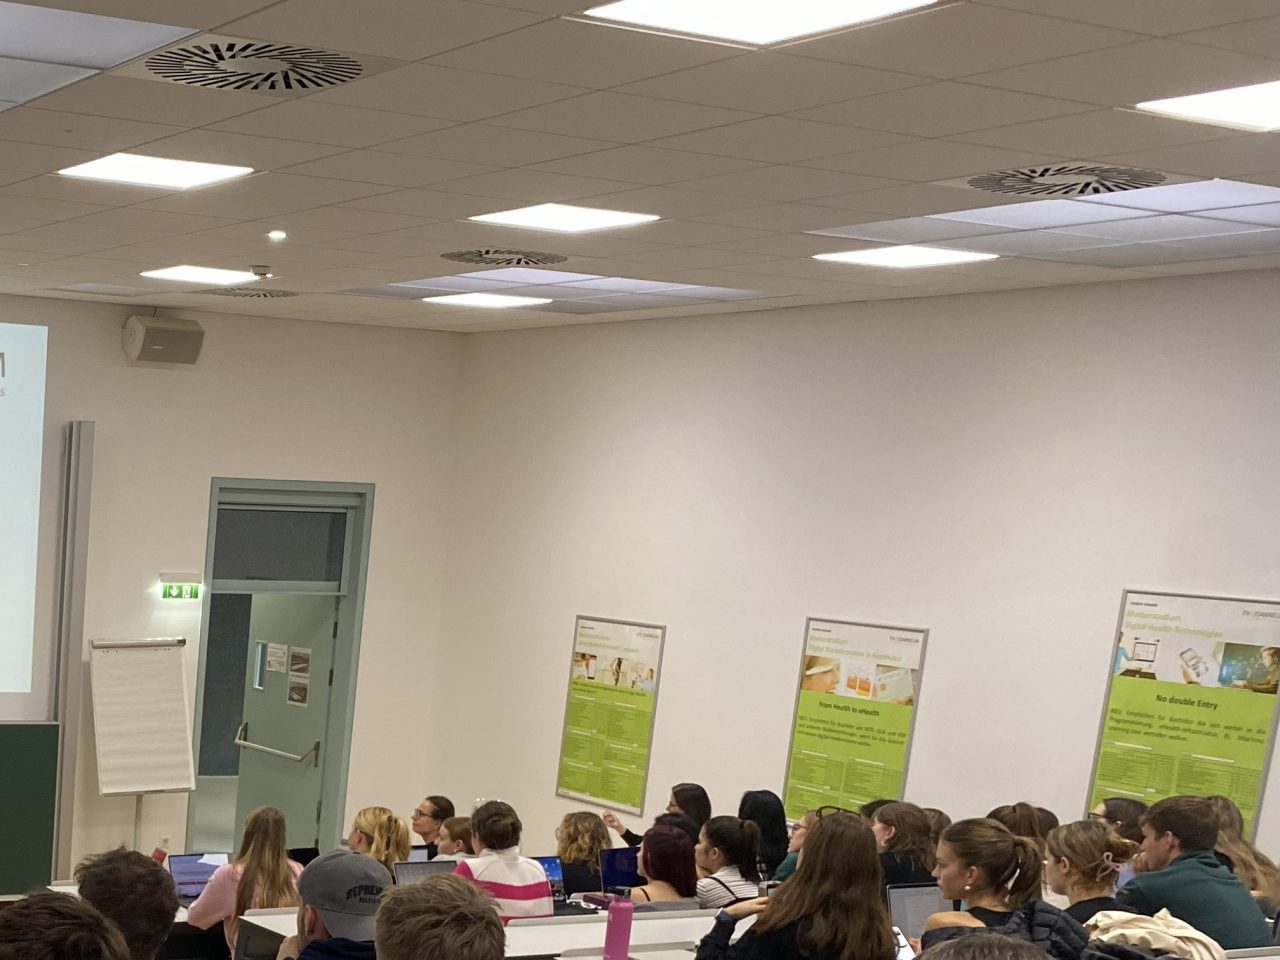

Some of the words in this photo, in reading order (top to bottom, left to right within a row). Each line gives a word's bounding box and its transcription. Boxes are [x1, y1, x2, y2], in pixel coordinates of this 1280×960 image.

[1155, 694, 1167, 703] No
[1169, 695, 1195, 707] double
[1197, 700, 1218, 711] Entry
